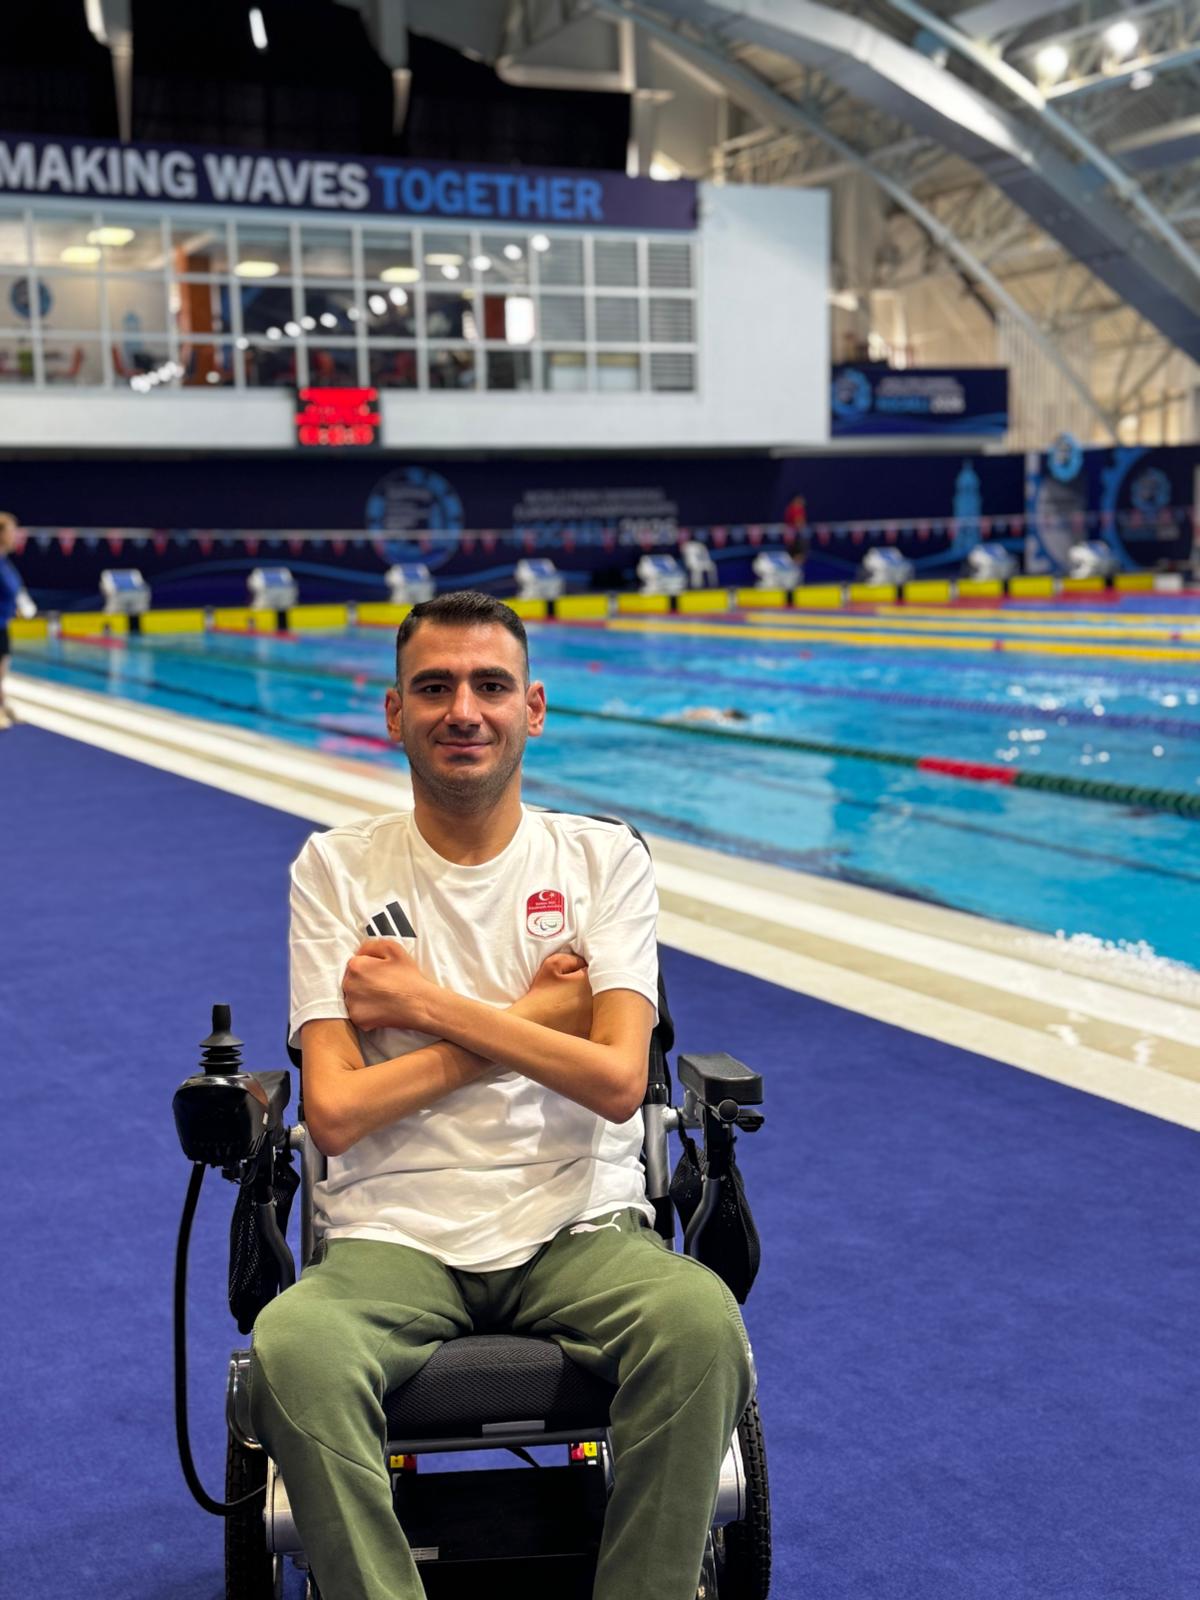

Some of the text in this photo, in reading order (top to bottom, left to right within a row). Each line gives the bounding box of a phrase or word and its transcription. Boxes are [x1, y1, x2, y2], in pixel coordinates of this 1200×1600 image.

[0, 141, 603, 221] MAKING WAVES TOGETHER
